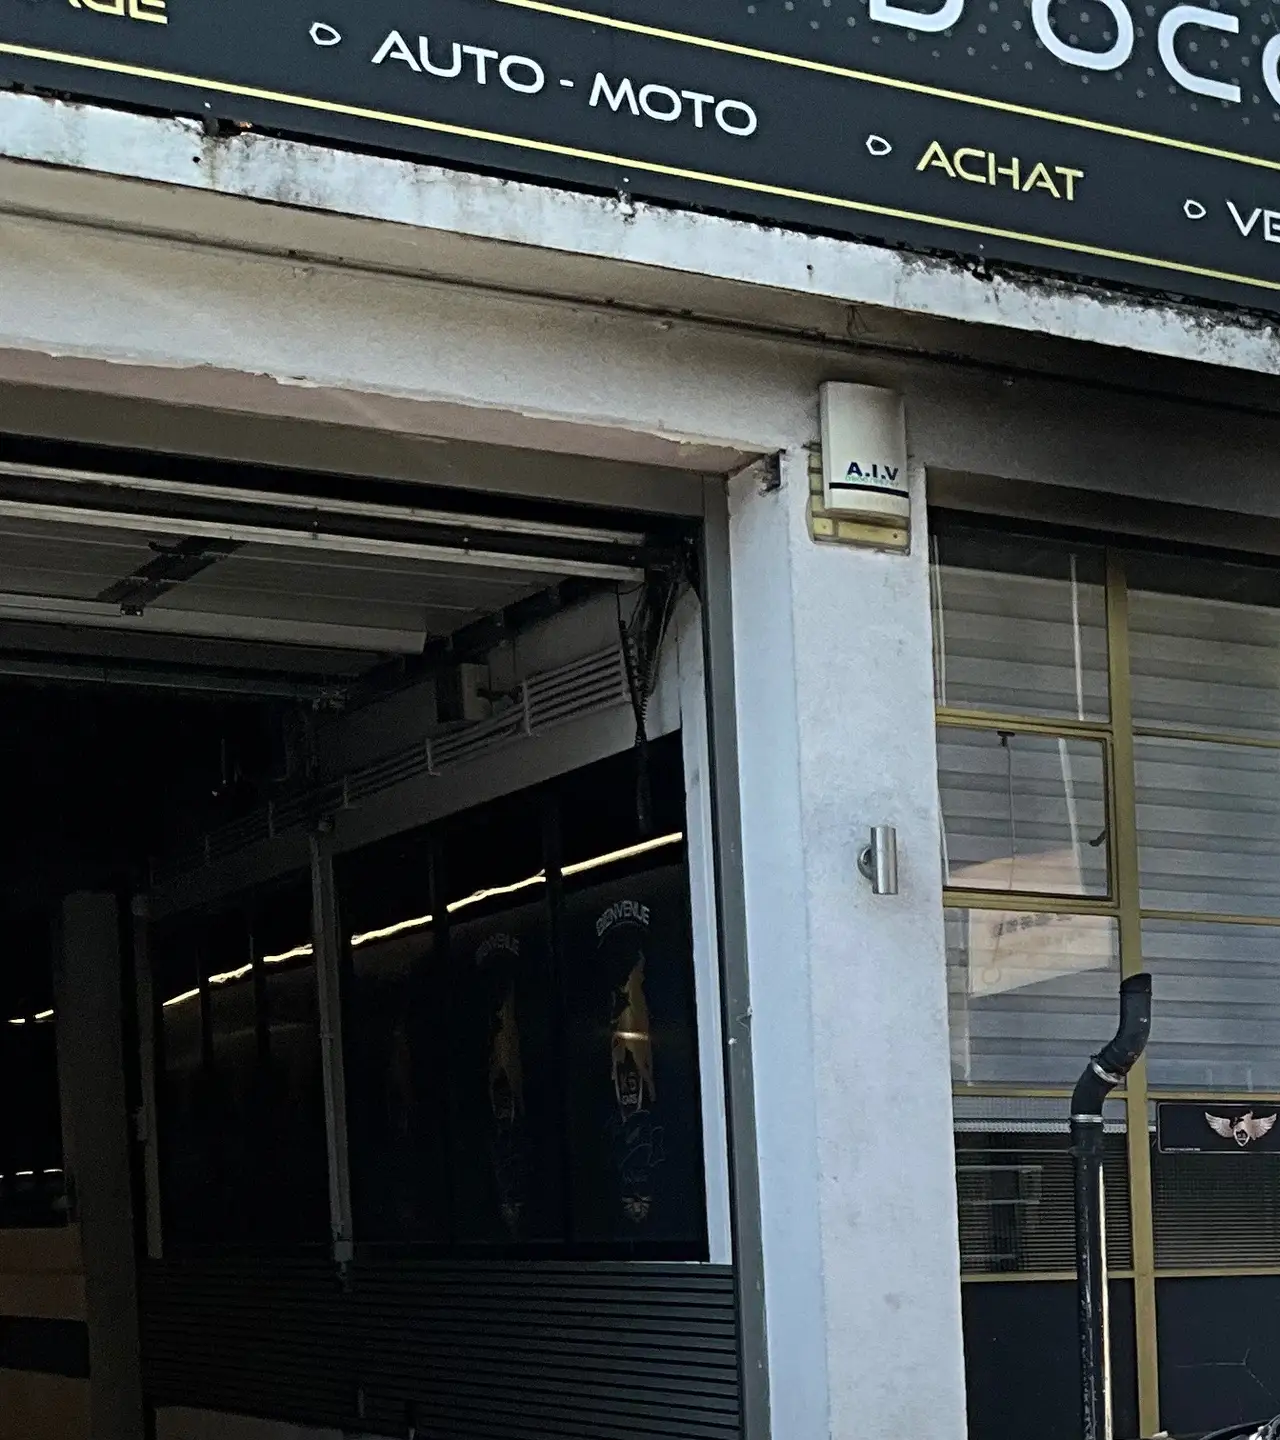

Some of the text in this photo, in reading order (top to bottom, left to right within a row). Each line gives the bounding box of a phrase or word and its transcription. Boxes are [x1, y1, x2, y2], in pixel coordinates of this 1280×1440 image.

[371, 30, 545, 97] AUTO
[588, 72, 758, 137] MOTO
[915, 139, 1085, 202] ACHAT
